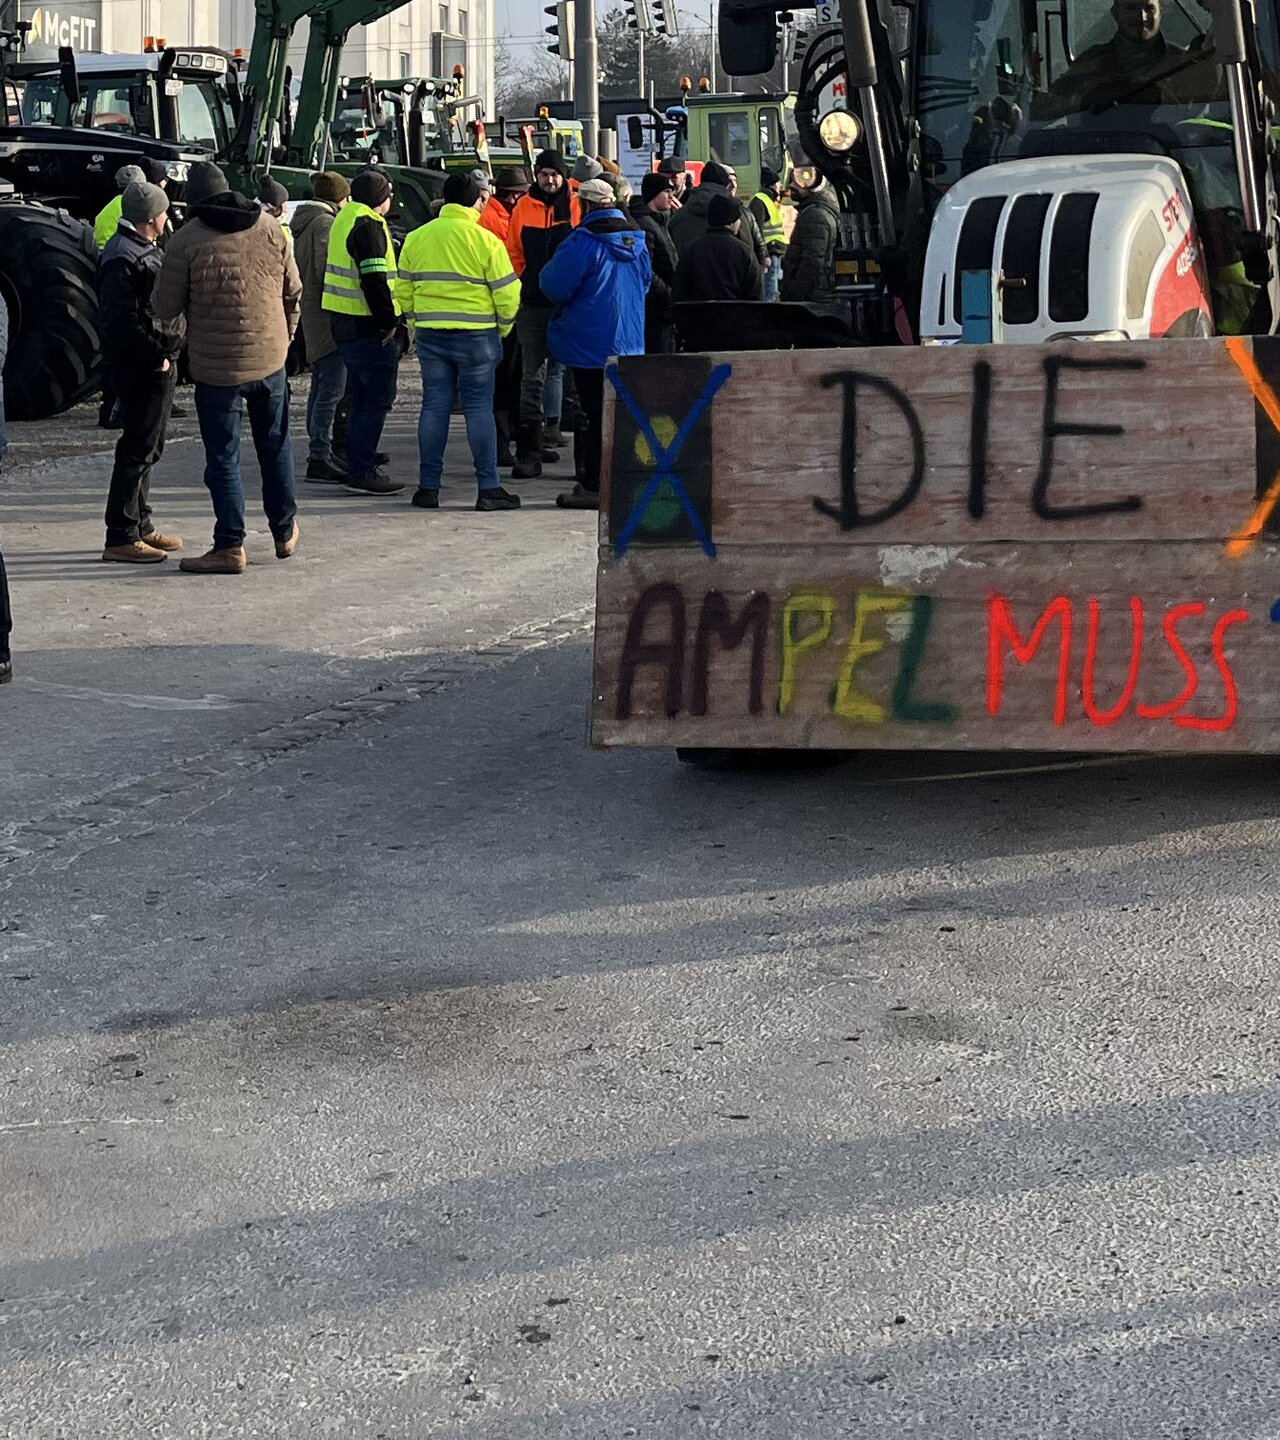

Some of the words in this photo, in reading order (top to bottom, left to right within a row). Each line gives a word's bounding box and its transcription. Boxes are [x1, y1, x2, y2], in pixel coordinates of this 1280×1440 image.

[44, 10, 96, 51] McFIT
[812, 355, 1148, 533] DIE
[615, 580, 962, 727] AMPEL
[984, 593, 1250, 732] MUSS
